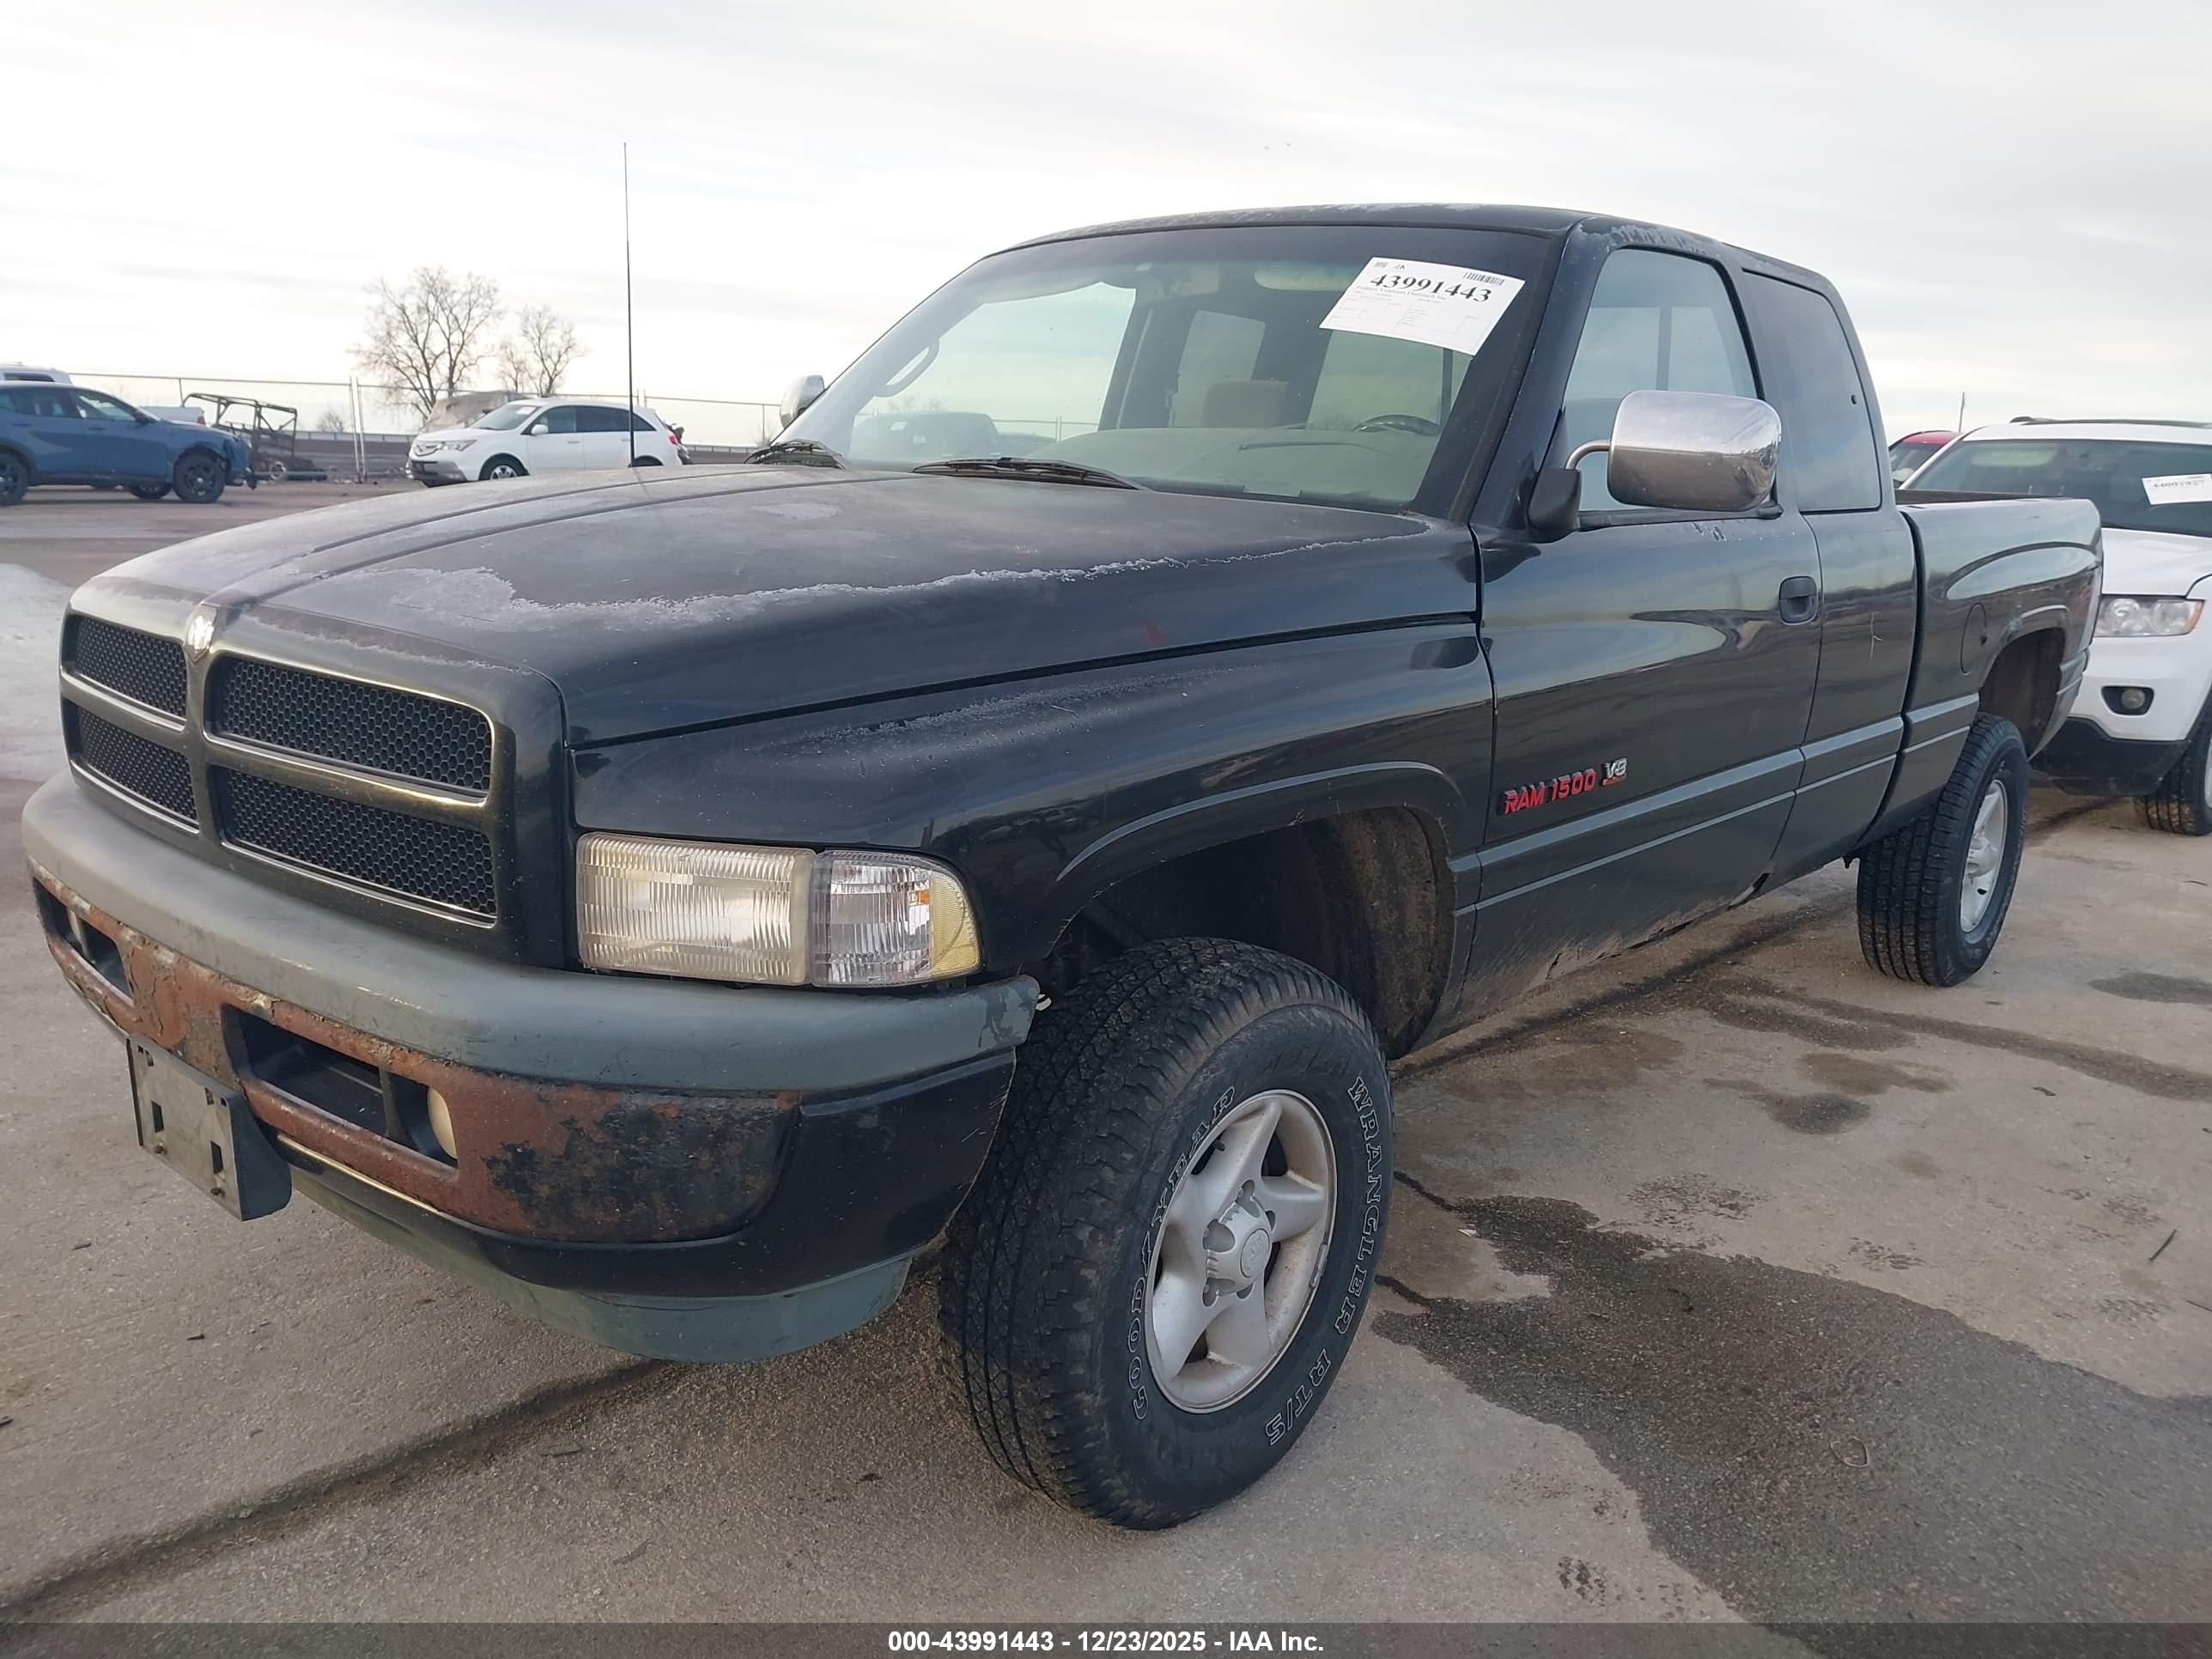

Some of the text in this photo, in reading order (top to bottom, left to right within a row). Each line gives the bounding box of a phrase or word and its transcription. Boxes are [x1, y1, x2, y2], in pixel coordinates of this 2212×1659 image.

[1370, 273, 1492, 302] 43991443
[1504, 781, 1547, 814] RAM
[1550, 768, 1597, 802] 1500
[1334, 1076, 1382, 1335] WRANGLER
